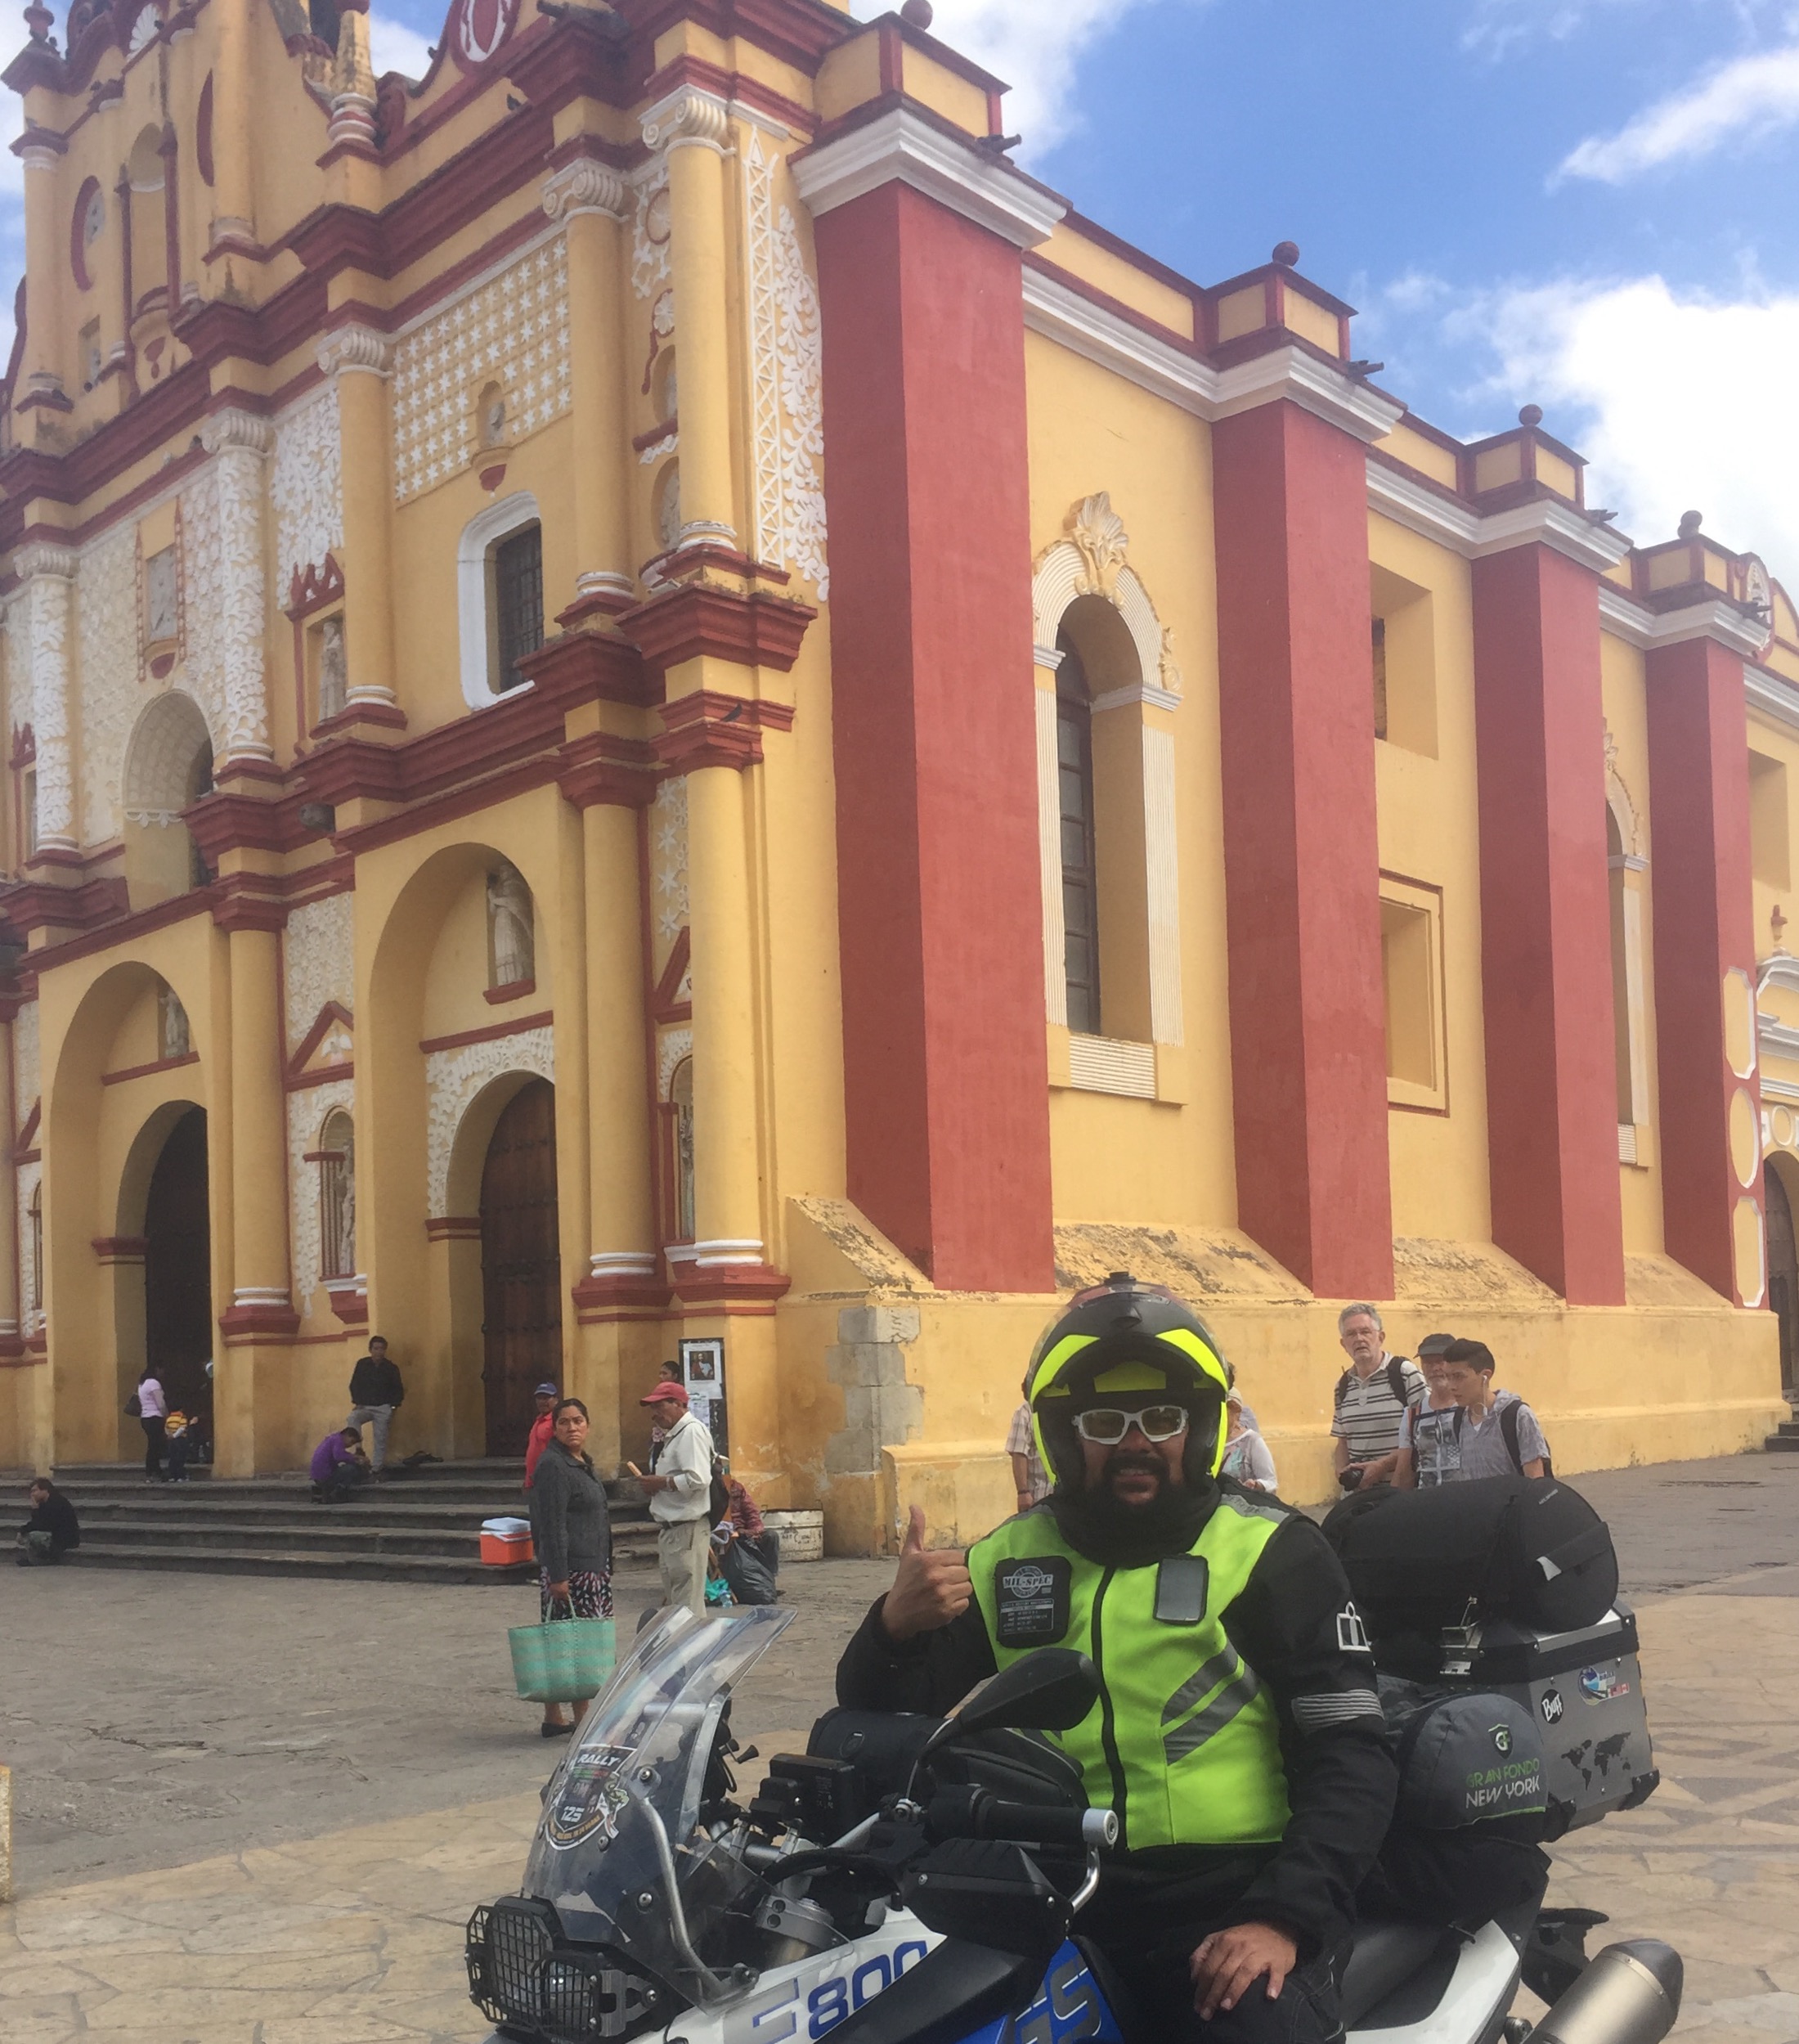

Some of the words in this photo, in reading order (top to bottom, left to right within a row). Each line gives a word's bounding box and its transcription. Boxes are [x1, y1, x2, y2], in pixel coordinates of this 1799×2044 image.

[1004, 1575, 1052, 1587] MIL-SPEC
[577, 1754, 618, 1766] RALLY
[1466, 1768, 1501, 1788] GRAN
[1504, 1758, 1540, 1780] FONDO
[1465, 1785, 1503, 1808] NEW
[1505, 1775, 1540, 1799] YORK
